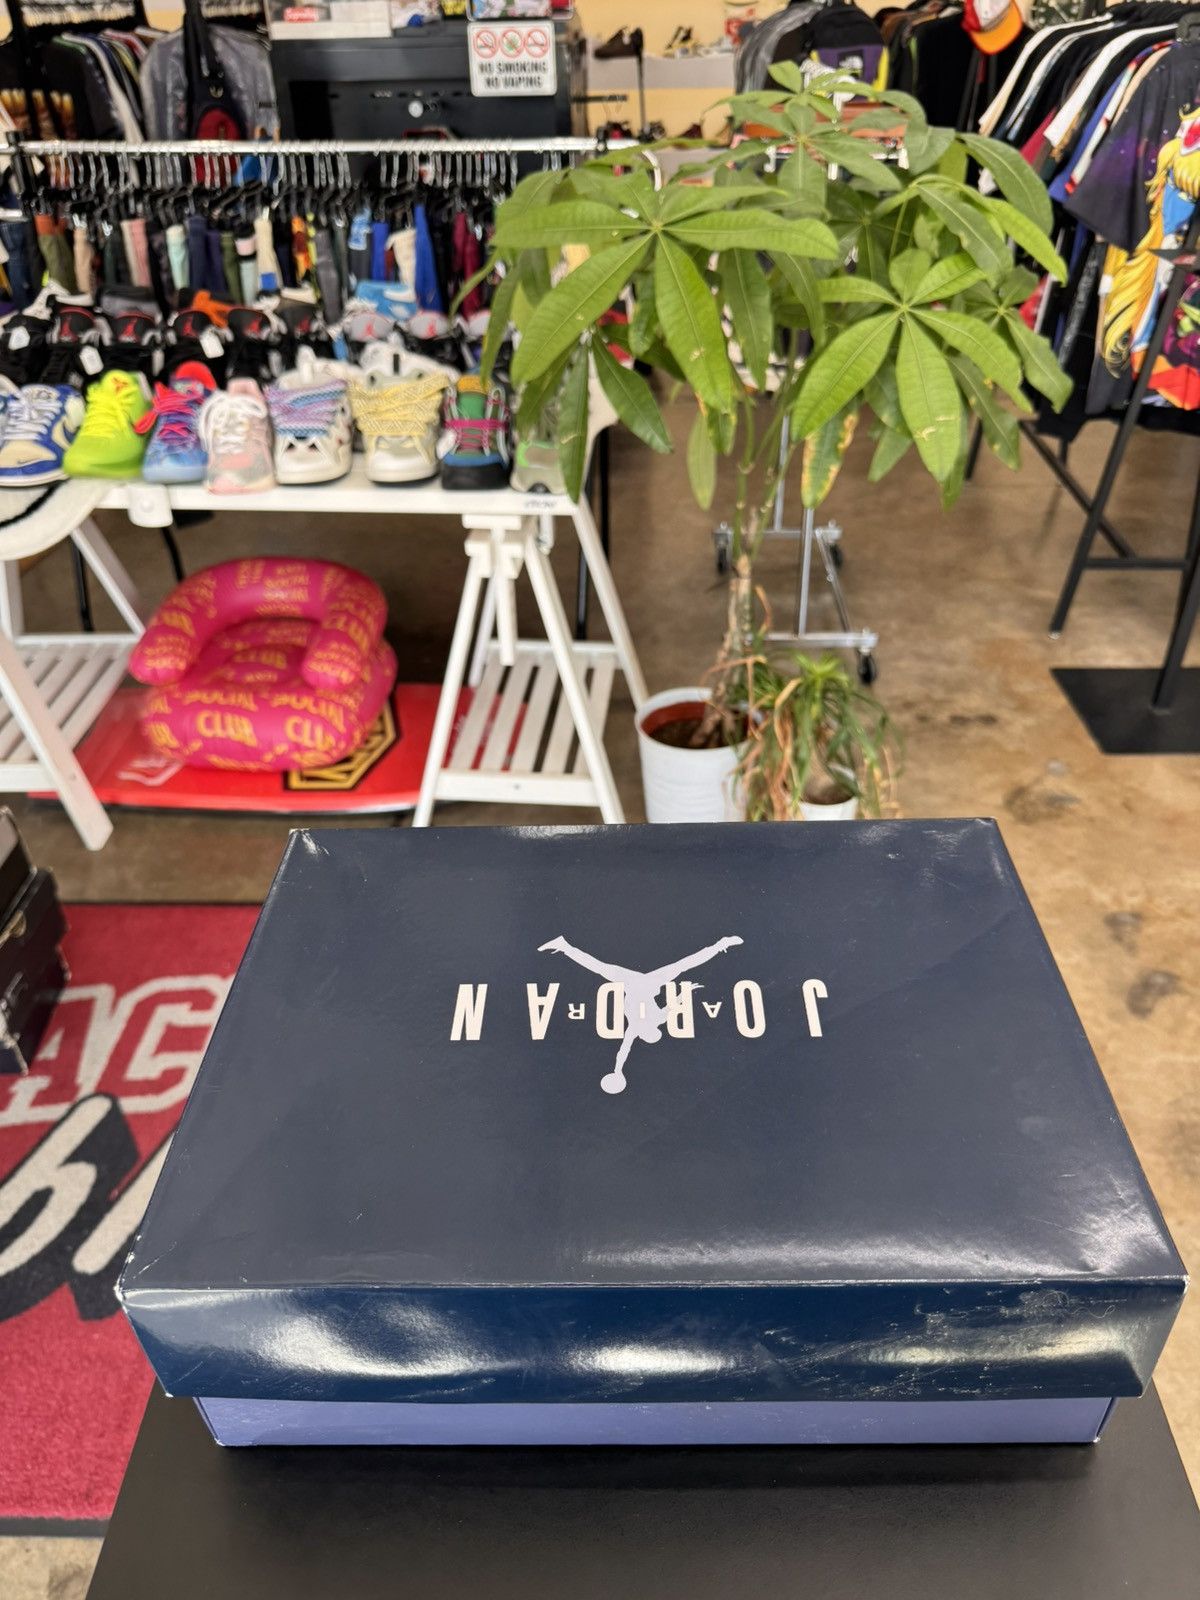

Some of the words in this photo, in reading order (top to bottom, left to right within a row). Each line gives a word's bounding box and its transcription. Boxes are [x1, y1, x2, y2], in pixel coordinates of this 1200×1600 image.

[478, 62, 494, 73] NO
[497, 61, 547, 73] SMOKING
[484, 76, 499, 88] NO
[503, 76, 543, 88] VAPING
[449, 978, 829, 1041] JORDAN
